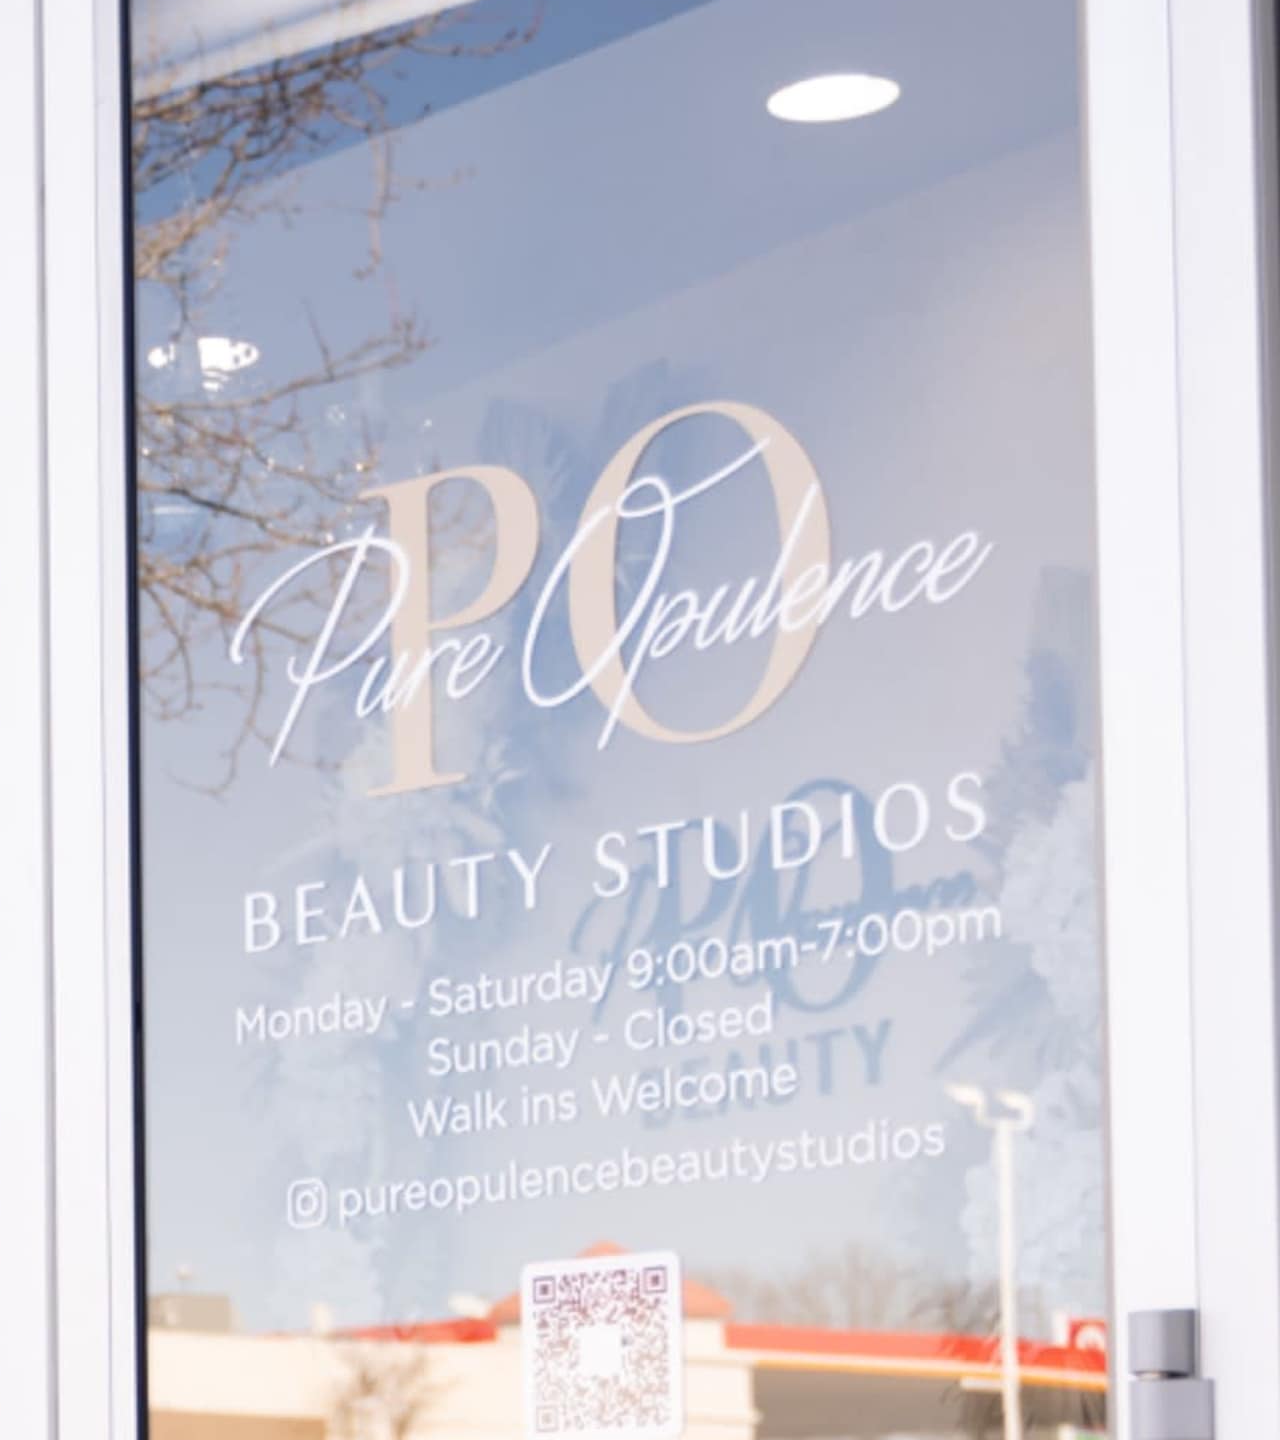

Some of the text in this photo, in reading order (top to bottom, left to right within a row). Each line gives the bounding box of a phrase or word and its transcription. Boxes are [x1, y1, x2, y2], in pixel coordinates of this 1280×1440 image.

[230, 436, 992, 767] Pure Opulence
[243, 844, 553, 953] BEAUTY
[592, 772, 988, 898] STUDIOS
[236, 991, 387, 1043] Monday
[428, 956, 613, 1017] Saturday
[627, 903, 1003, 990] 9:00am-7:00pm
[427, 1027, 579, 1078] Sunday
[624, 992, 774, 1054] Closed
[408, 1056, 798, 1138] Walk ins Welcome
[339, 1118, 947, 1222] pureopulencebeautystudios
